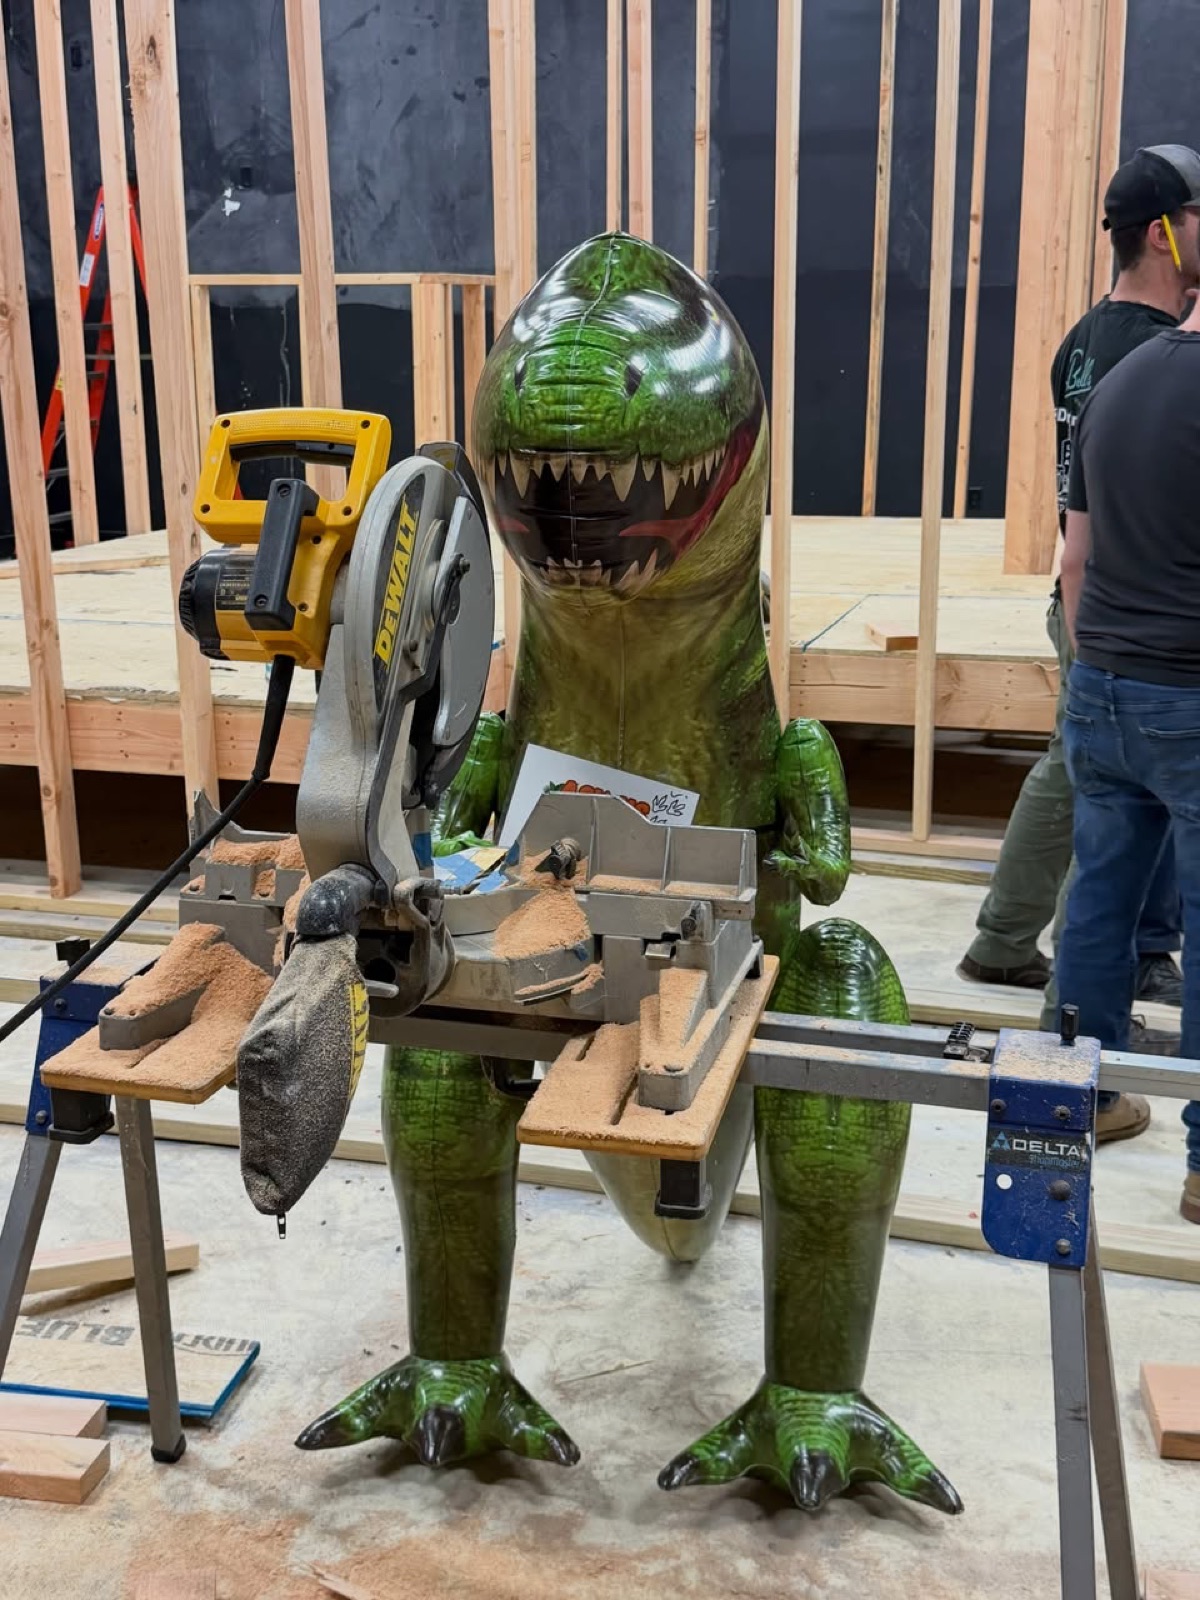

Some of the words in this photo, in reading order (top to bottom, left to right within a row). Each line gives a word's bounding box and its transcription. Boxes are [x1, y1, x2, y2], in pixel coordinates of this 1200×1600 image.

[374, 496, 419, 668] DEWALT
[1012, 1138, 1081, 1157] DELTA
[15, 1317, 136, 1346] BLUE
